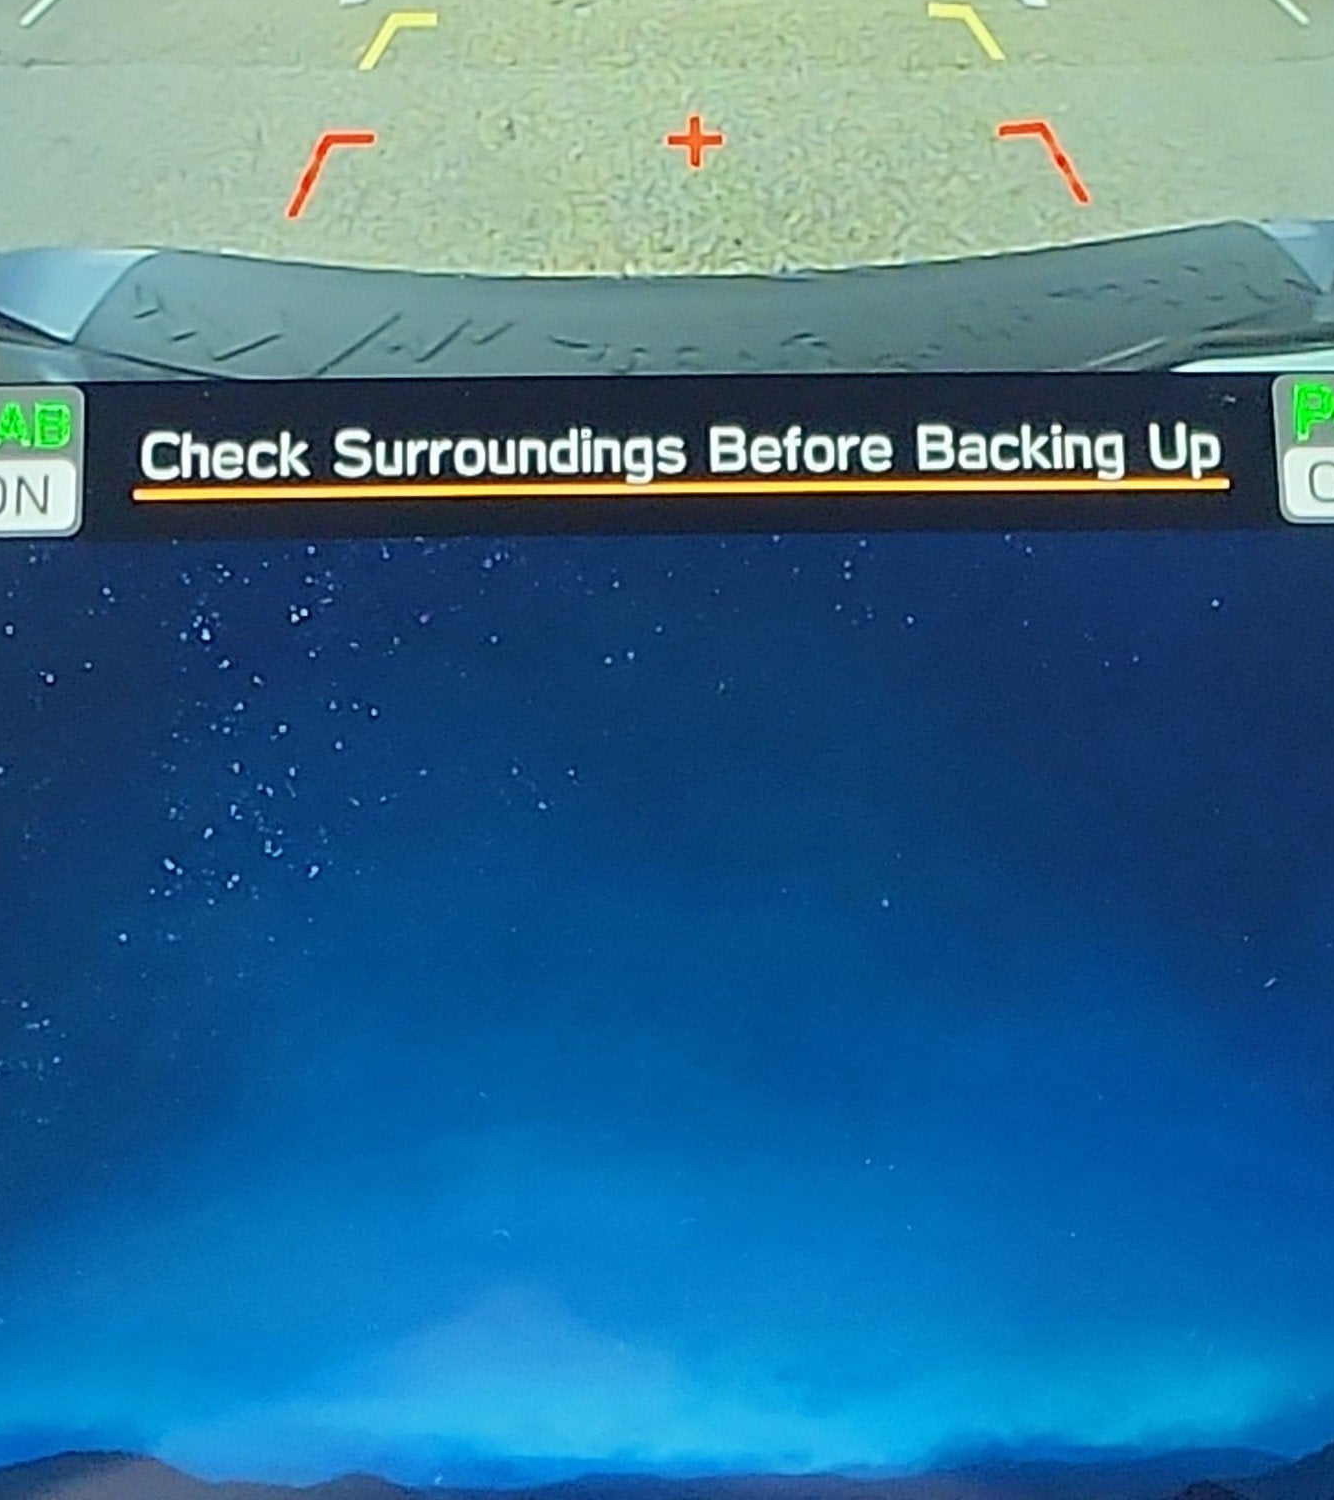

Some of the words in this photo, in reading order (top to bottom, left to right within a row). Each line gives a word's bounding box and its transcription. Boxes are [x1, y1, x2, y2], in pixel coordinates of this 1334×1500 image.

[139, 429, 312, 482] Check
[331, 426, 688, 485] Surroundings
[707, 423, 895, 474] Before
[915, 420, 1127, 481] Backing
[1147, 420, 1222, 480] Up
